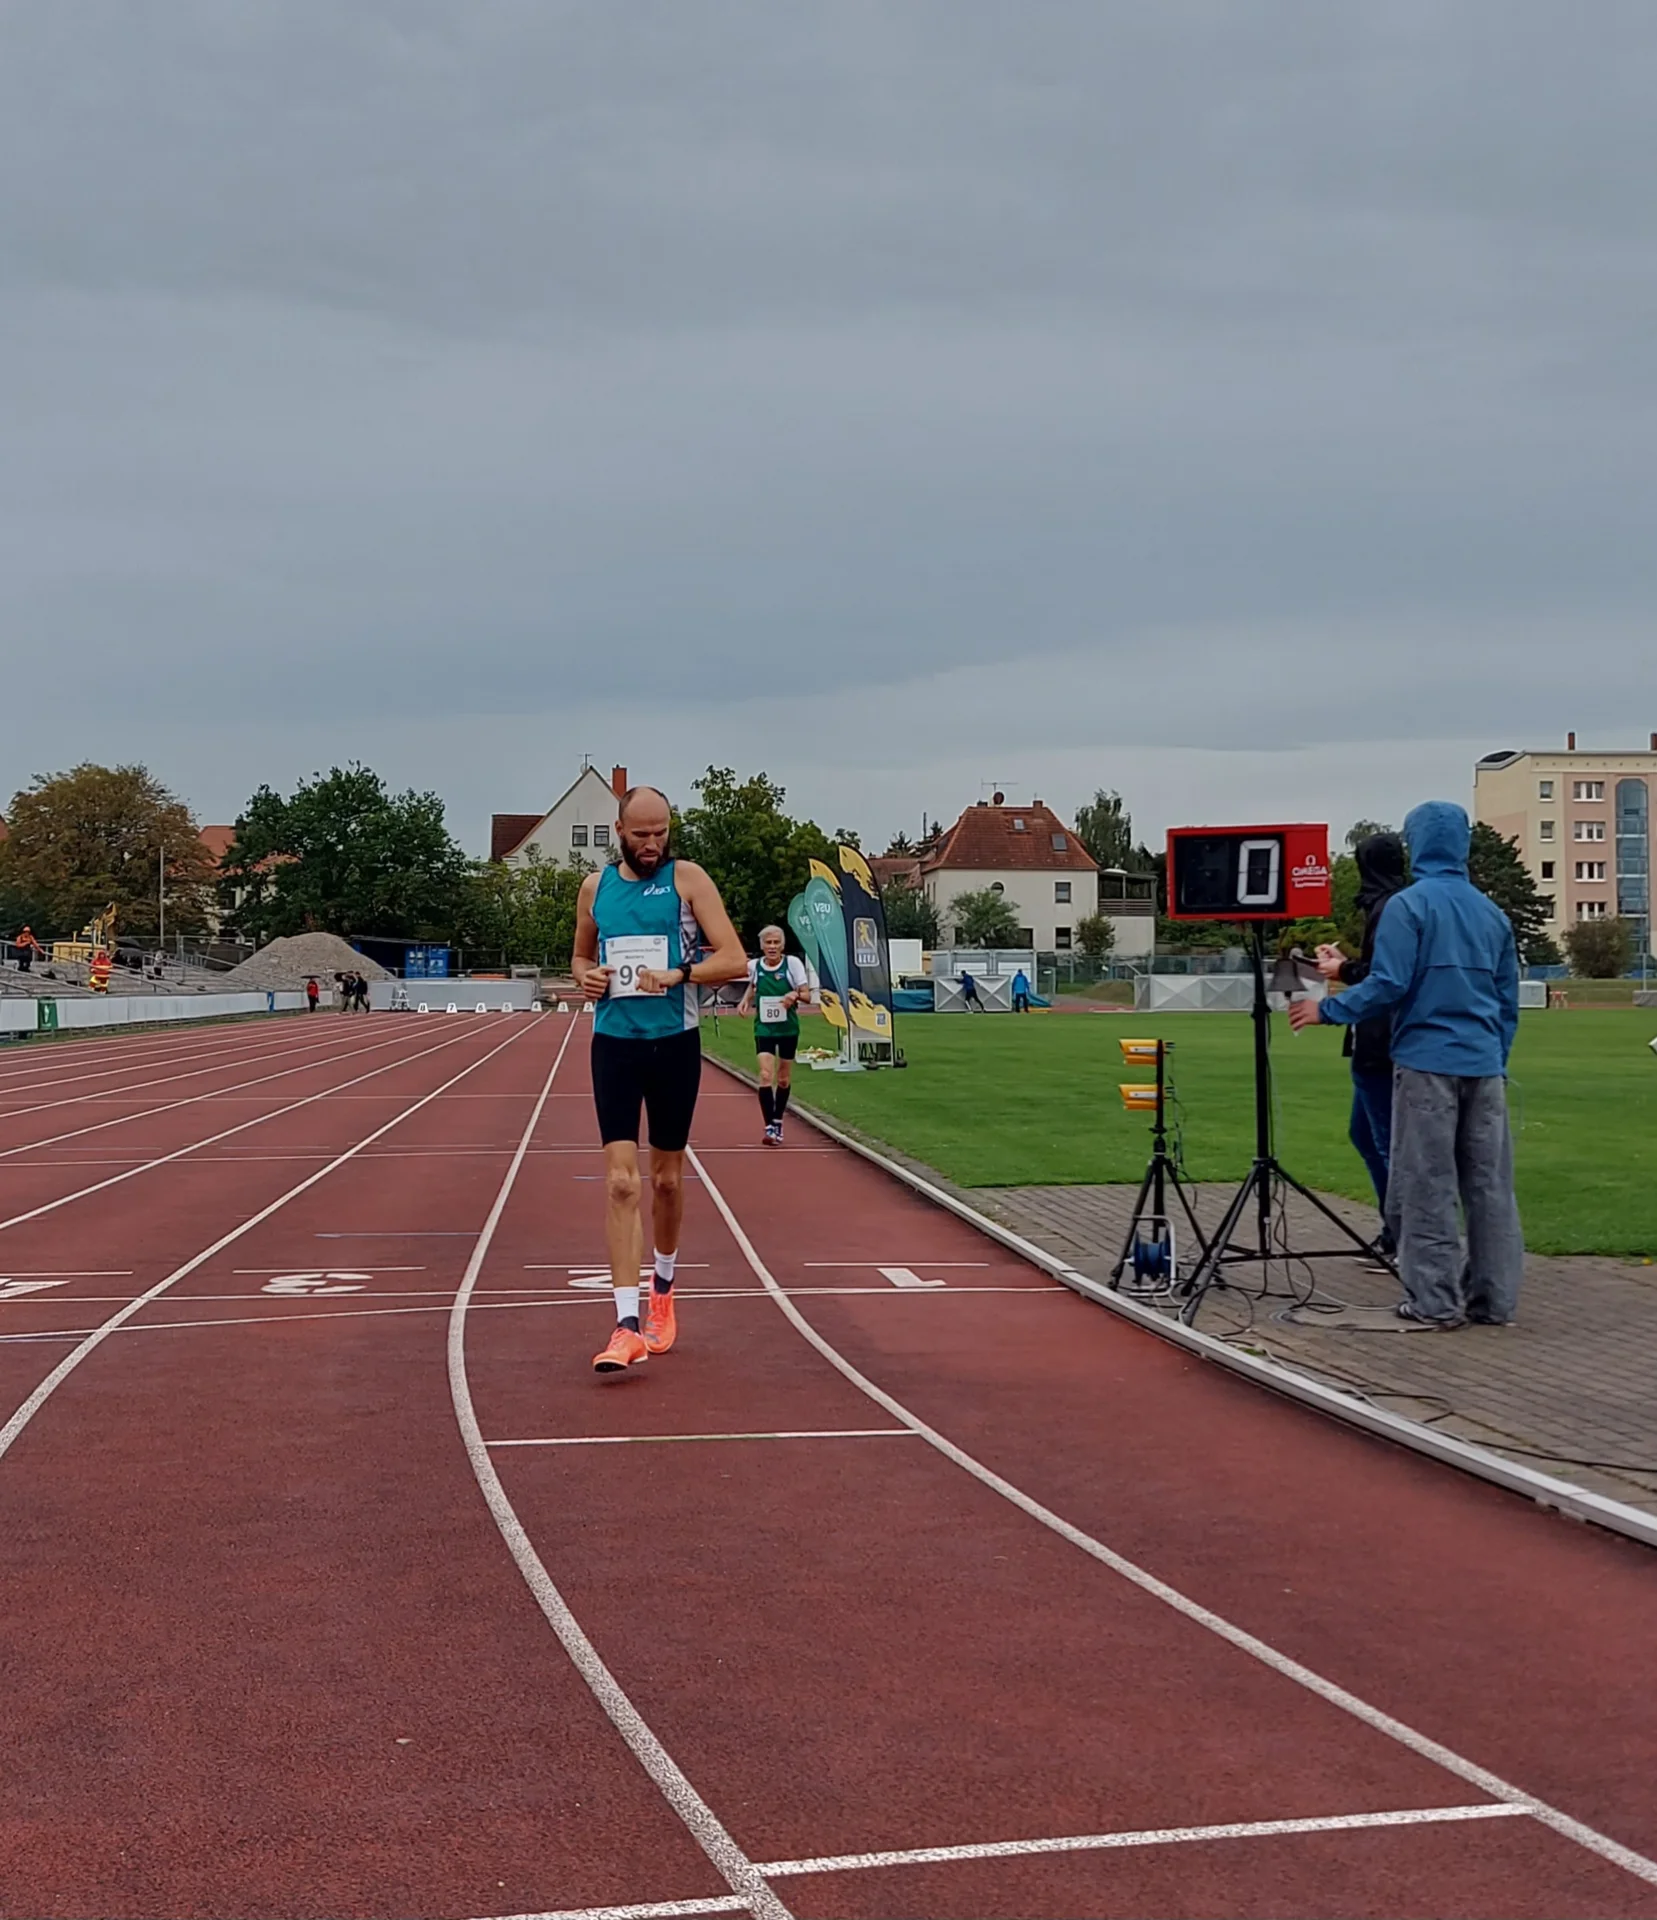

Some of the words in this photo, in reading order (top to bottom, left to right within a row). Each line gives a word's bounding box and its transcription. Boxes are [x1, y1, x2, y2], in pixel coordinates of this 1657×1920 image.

[1237, 839, 1280, 904] 0
[766, 1008, 780, 1018] 80
[260, 1272, 374, 1294] 3
[876, 1267, 947, 1287] 1
